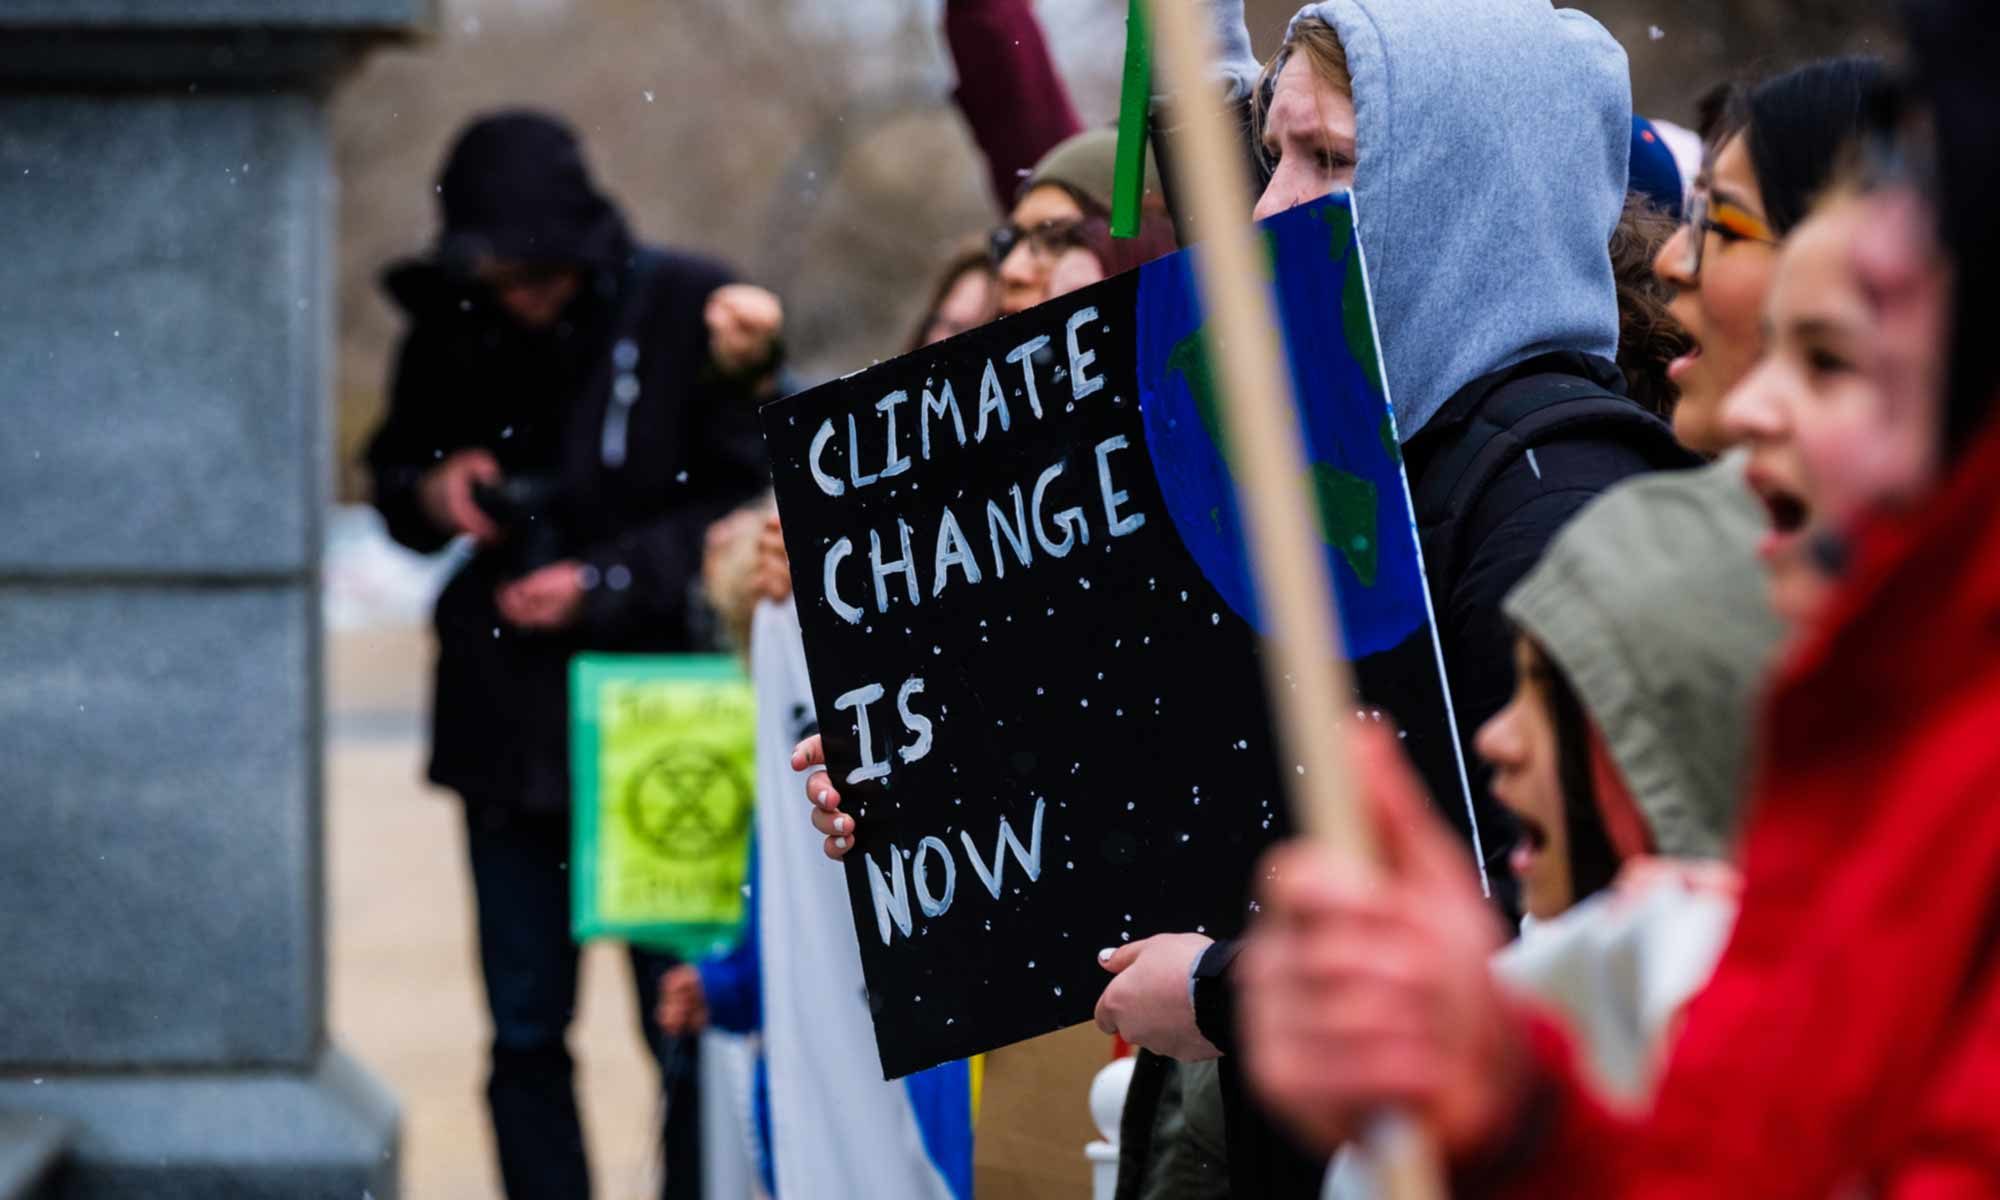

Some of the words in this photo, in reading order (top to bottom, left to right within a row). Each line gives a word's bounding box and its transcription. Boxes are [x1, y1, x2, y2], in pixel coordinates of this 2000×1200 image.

[809, 306, 1104, 496] CLIMATE
[823, 434, 1145, 624] CHANGE
[834, 677, 932, 784] IS
[865, 797, 1045, 946] NOW
